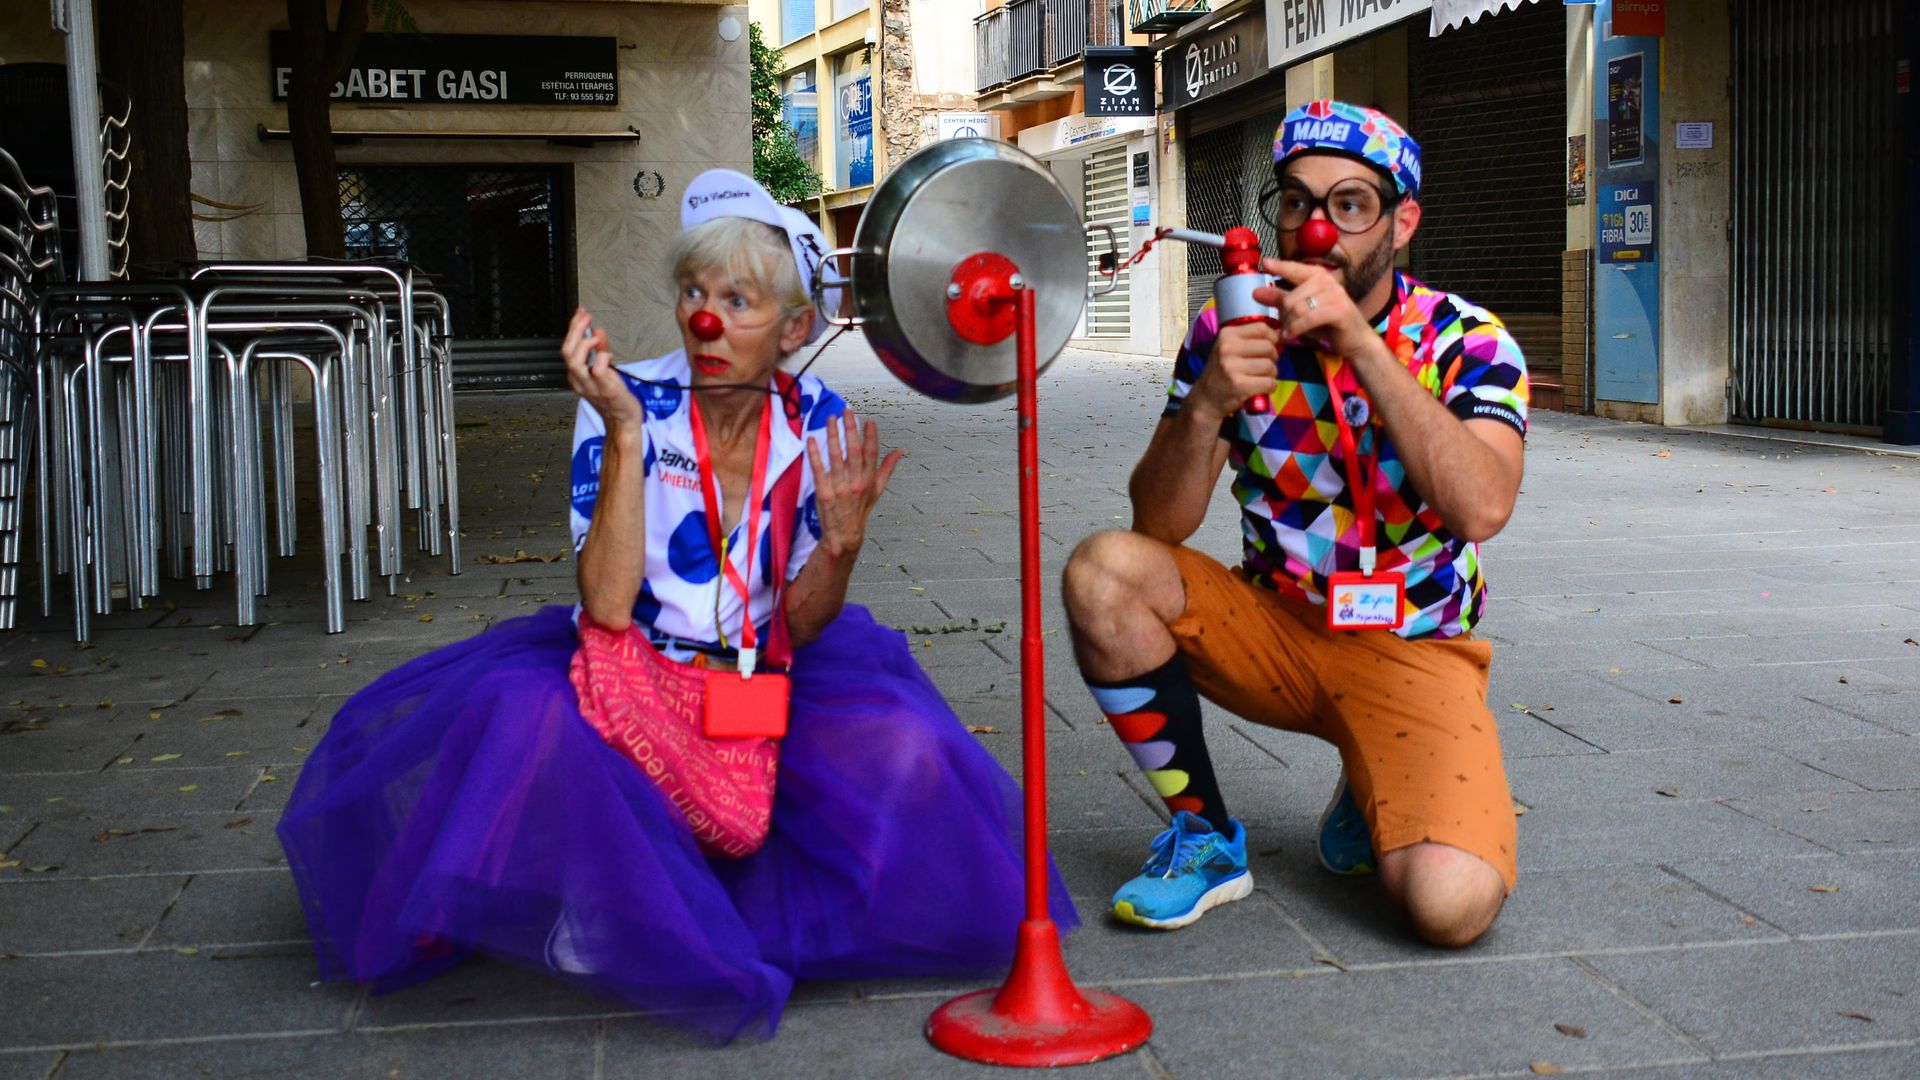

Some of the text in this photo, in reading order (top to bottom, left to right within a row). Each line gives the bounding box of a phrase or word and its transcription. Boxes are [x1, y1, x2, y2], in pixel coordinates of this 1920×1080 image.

[1616, 2, 1660, 15] simyo
[1283, 0, 1326, 49] FEM
[1203, 35, 1237, 66] ZIAN
[565, 71, 614, 80] PERRUQUERIA
[1204, 61, 1237, 85] TATTOO
[277, 67, 508, 99] EABET GASI
[581, 81, 614, 91] TERÀPIES
[554, 92, 614, 101] TLF: 93 555 56 27
[1100, 97, 1140, 105] ZIAN
[1293, 121, 1351, 142] MAPEI
[1614, 188, 1639, 202] DIGI
[1630, 211, 1643, 233] 30
[1602, 228, 1624, 243] FIBRA
